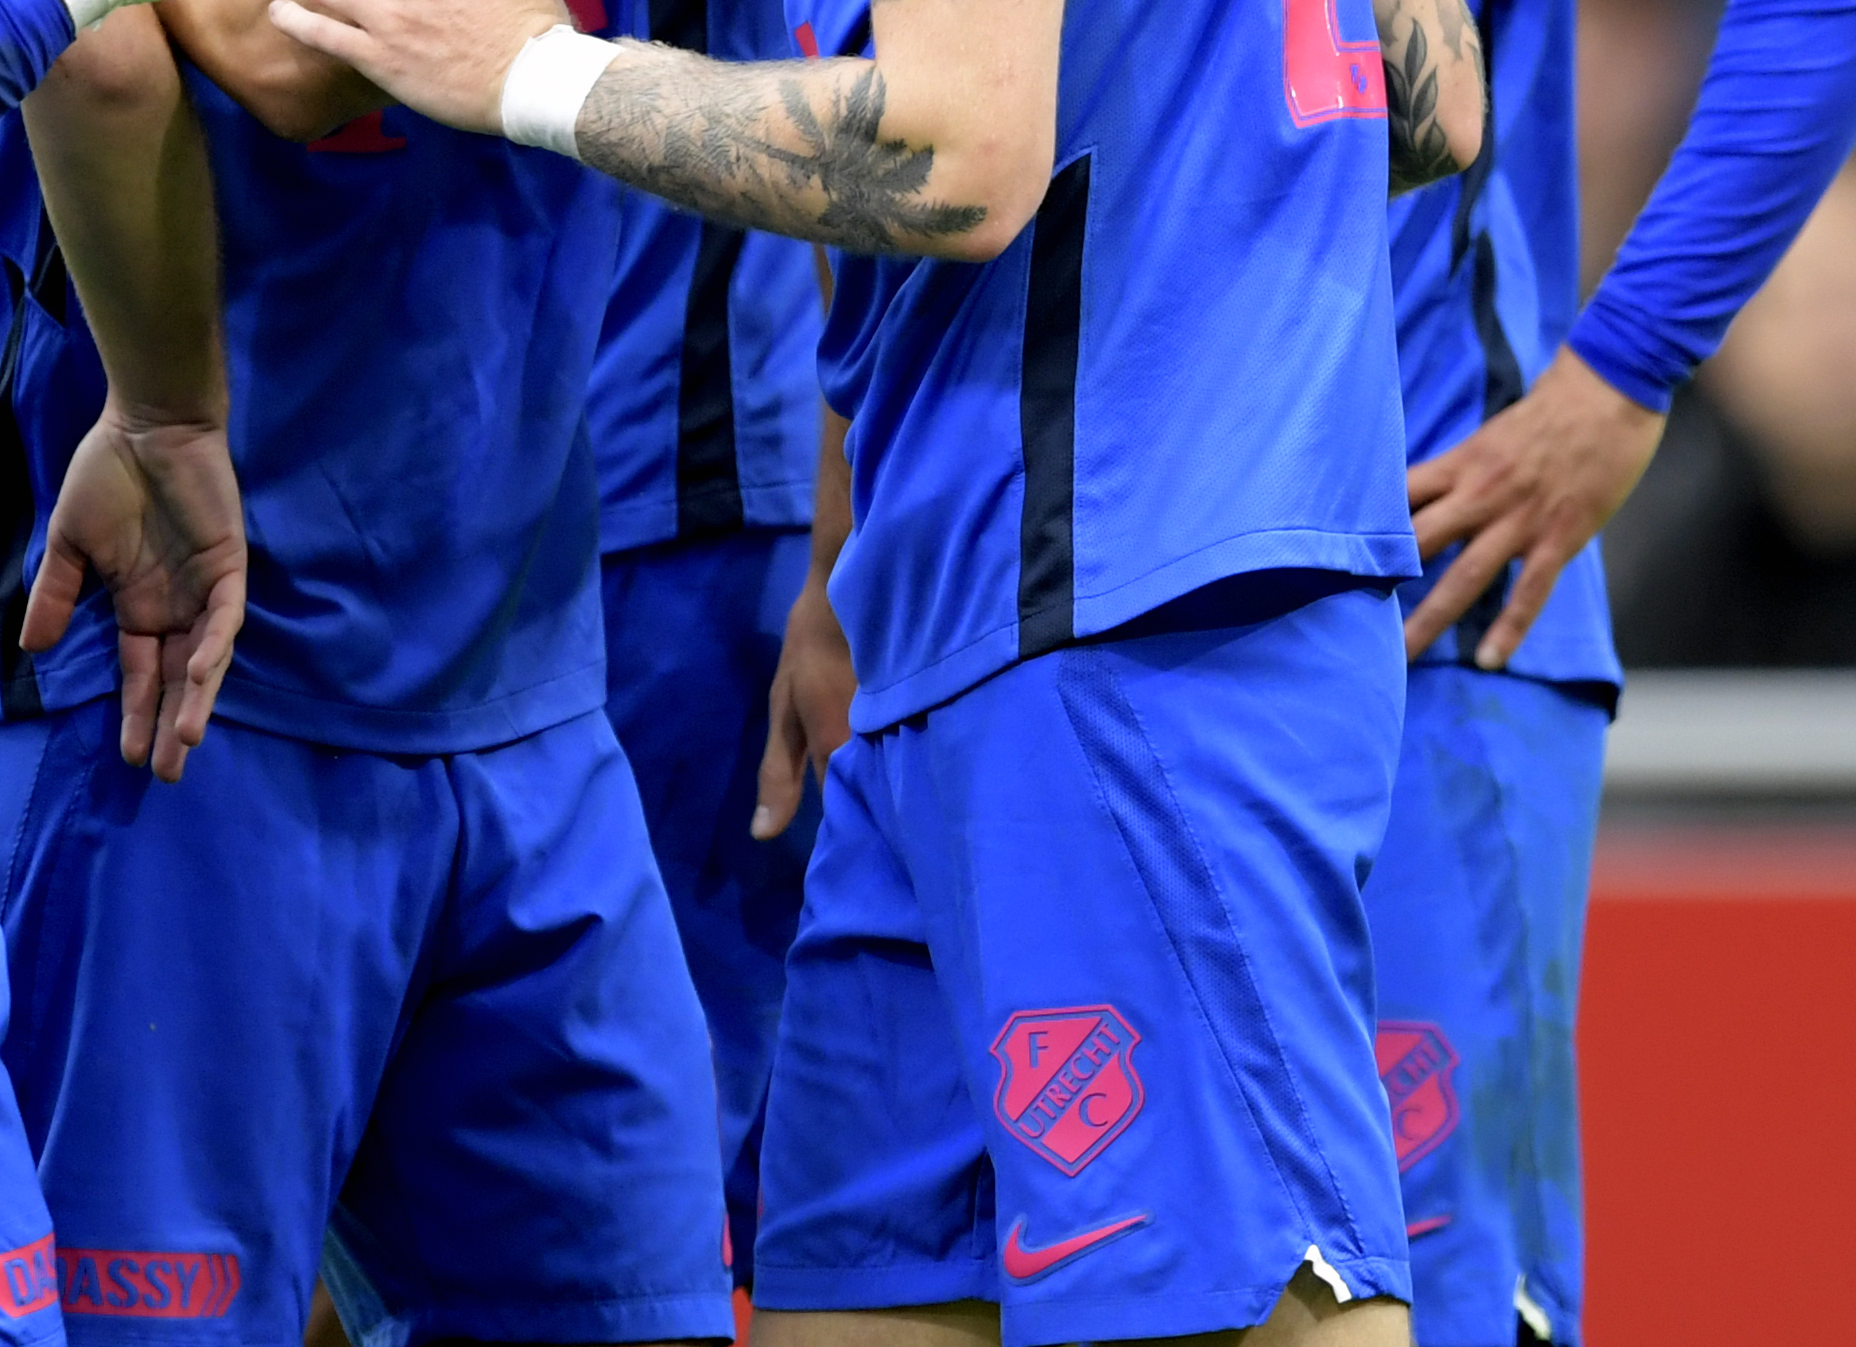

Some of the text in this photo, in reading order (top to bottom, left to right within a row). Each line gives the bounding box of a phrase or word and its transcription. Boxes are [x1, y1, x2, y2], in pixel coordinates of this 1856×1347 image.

[1028, 1030, 1050, 1070] F
[1018, 1022, 1122, 1139] UTRECHT
[1078, 1092, 1109, 1129] C
